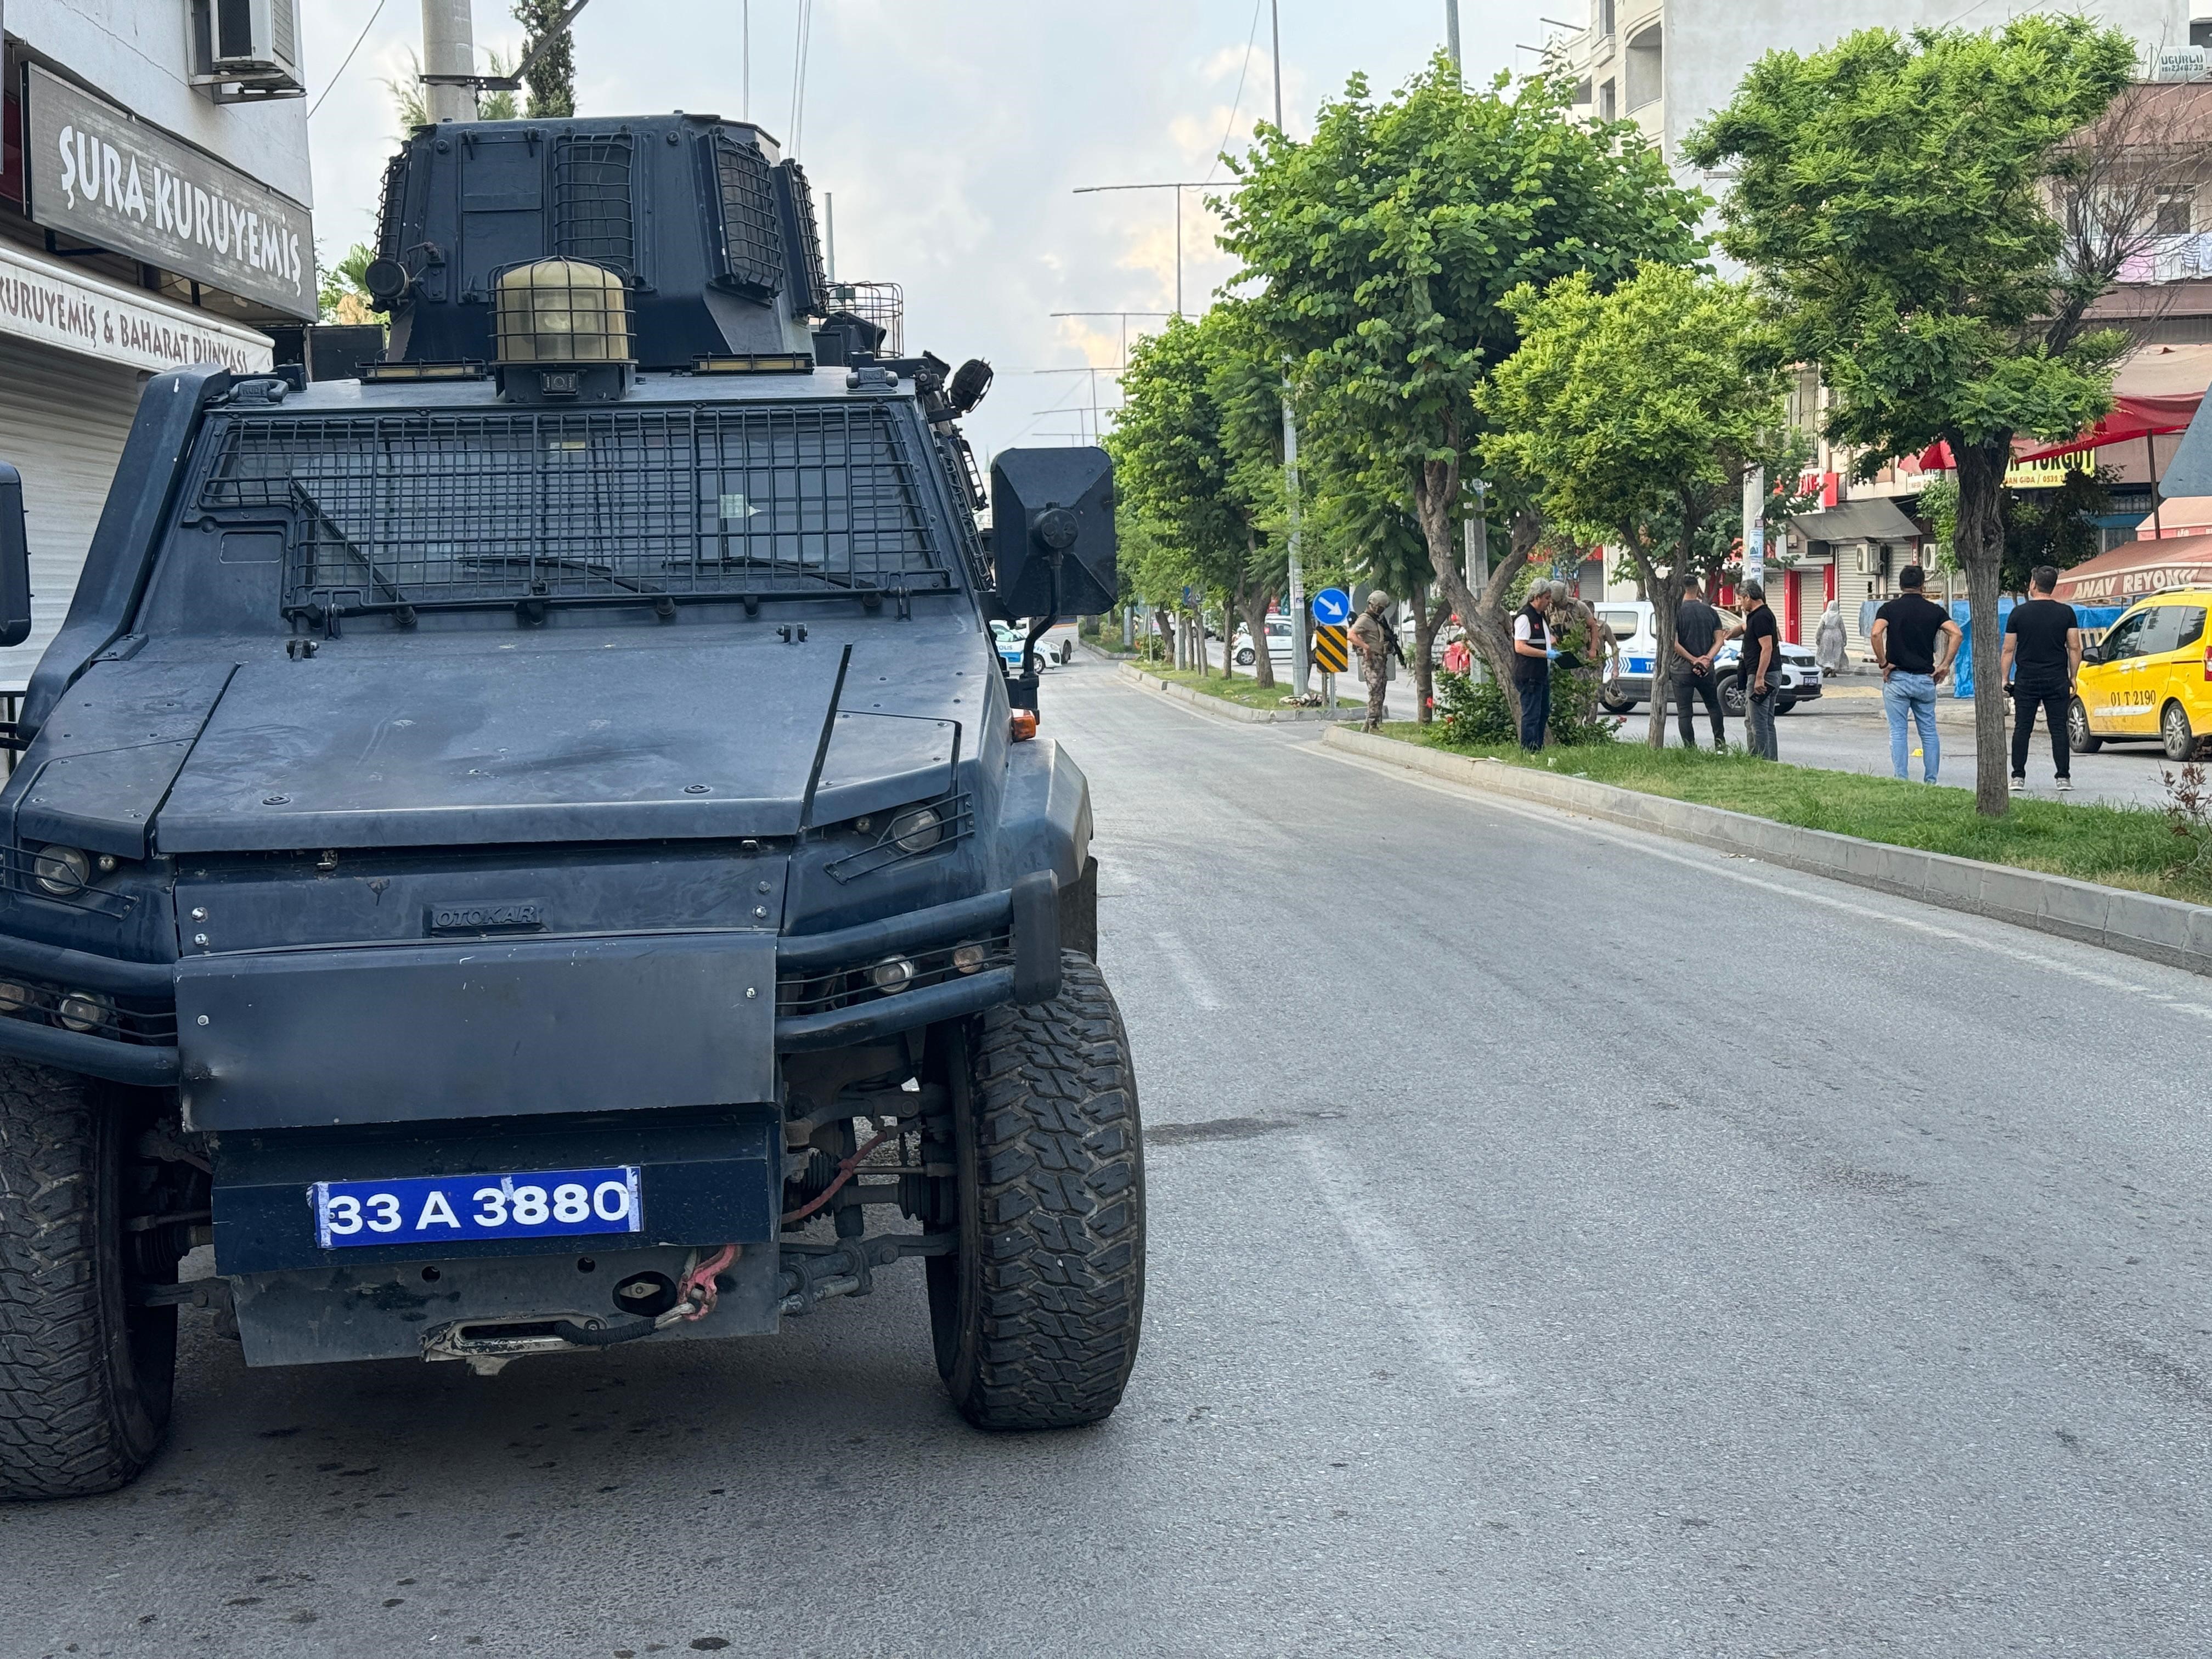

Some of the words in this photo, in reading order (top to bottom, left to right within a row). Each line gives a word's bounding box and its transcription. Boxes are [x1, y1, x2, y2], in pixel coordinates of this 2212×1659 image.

[59, 126, 148, 222] ŞURA
[154, 166, 301, 297] KURUYEMİŞ
[104, 310, 114, 345] &
[120, 314, 189, 364] BAHARAT
[2111, 691, 2121, 706] 01
[2124, 691, 2130, 706] T
[2133, 690, 2156, 705] 2190
[436, 906, 535, 927] OTOKAR
[329, 1193, 402, 1235] 33
[415, 1190, 461, 1231] A
[472, 1181, 630, 1227] 3880
